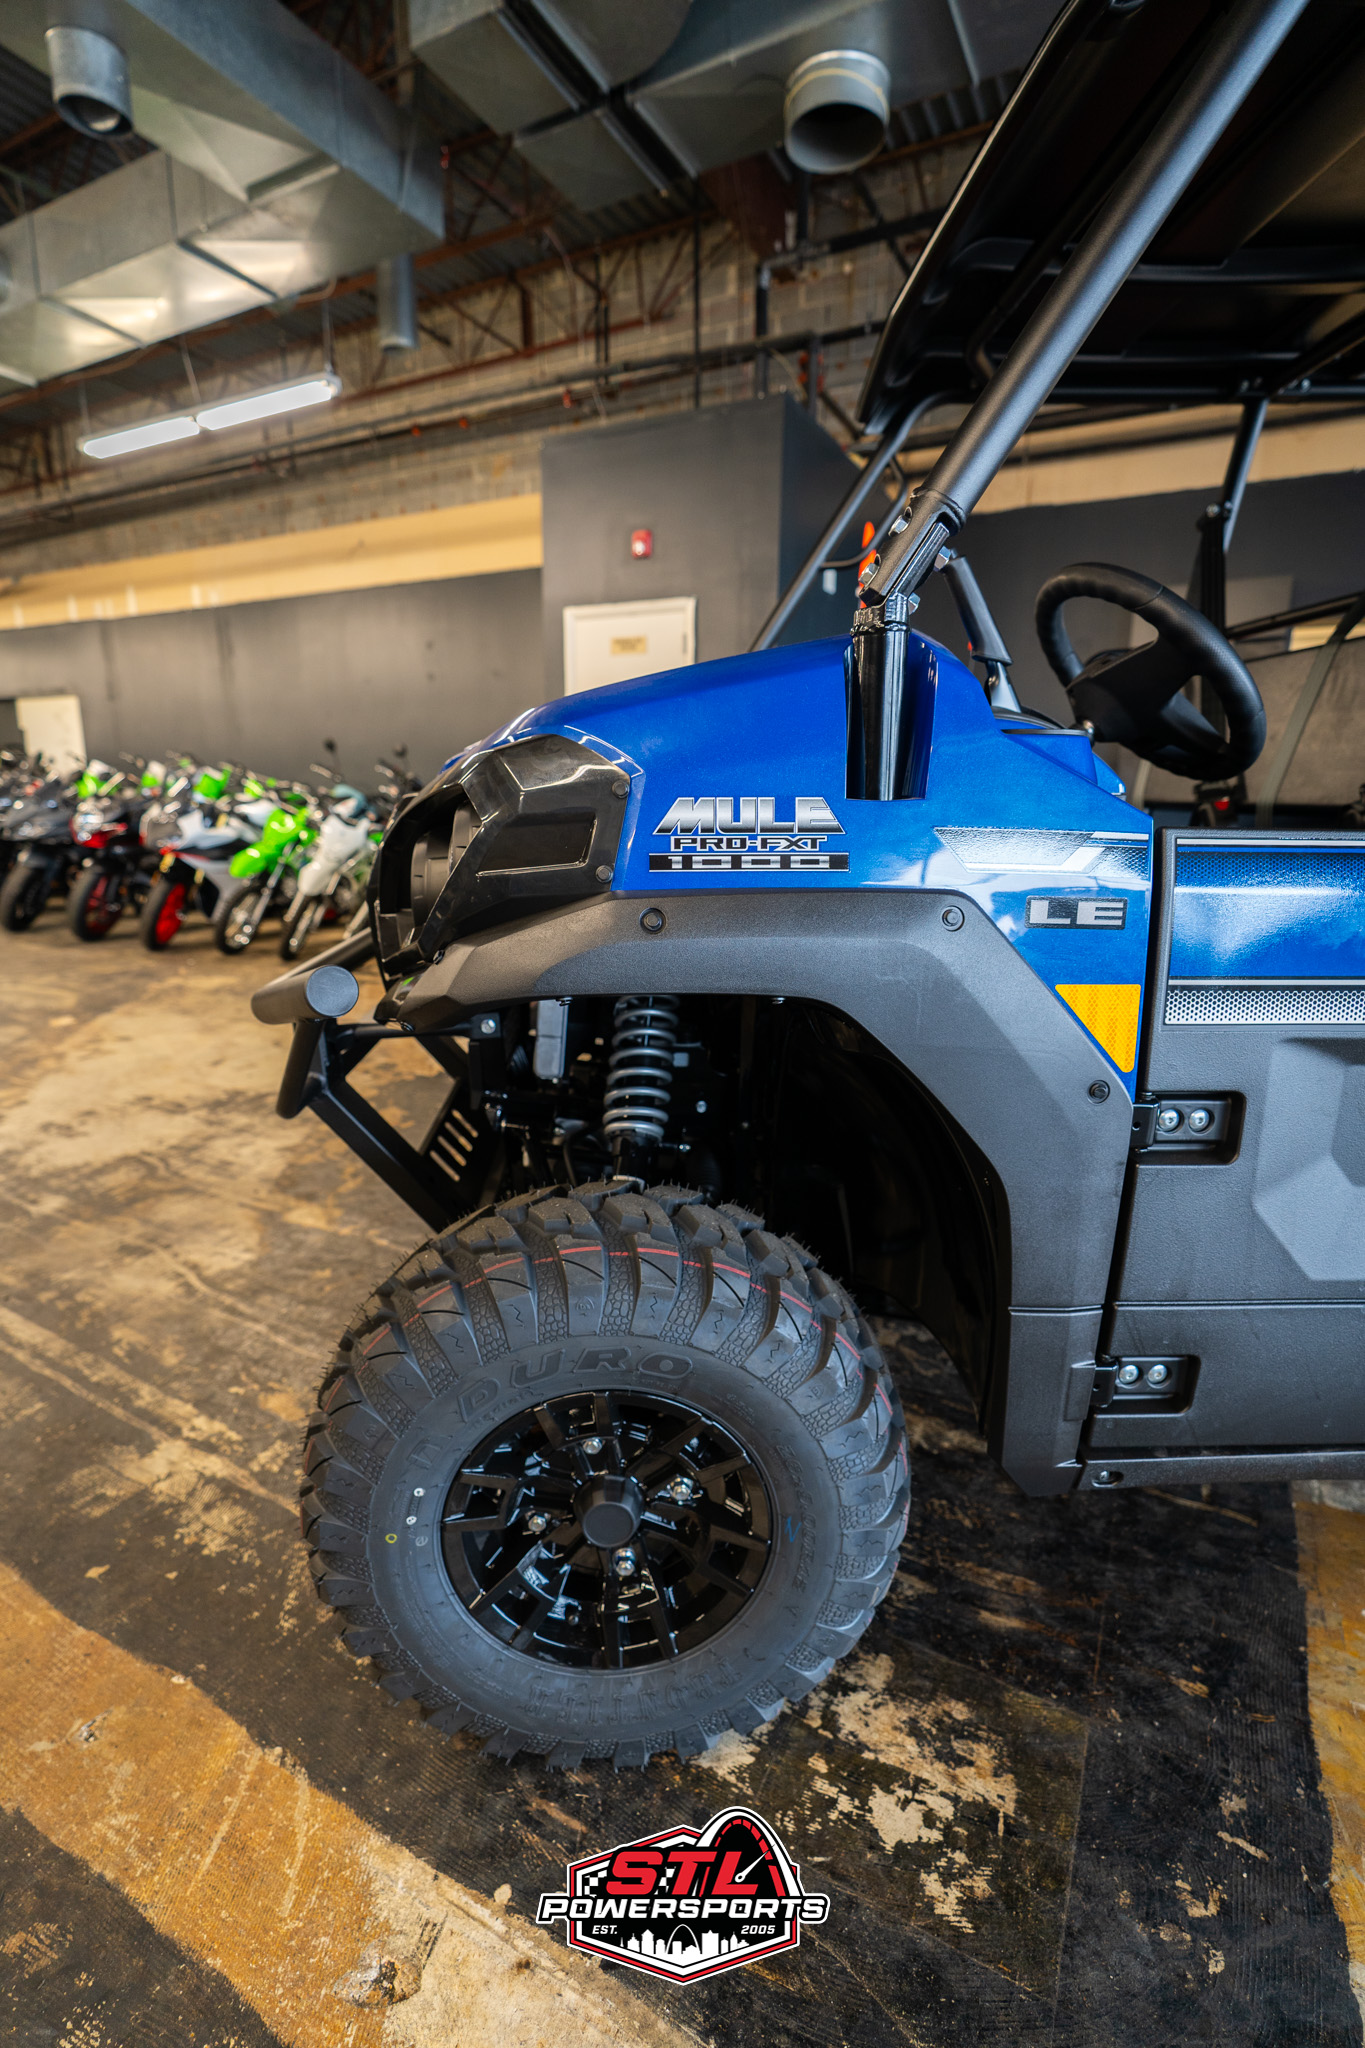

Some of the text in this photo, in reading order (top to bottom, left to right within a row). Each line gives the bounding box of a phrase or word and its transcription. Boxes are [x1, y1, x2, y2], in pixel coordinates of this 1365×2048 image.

[652, 796, 846, 835] MULE
[669, 835, 829, 852] PRO-FXT
[666, 855, 831, 870] 1000
[1028, 899, 1125, 926] LE
[456, 1346, 694, 1423] DURO
